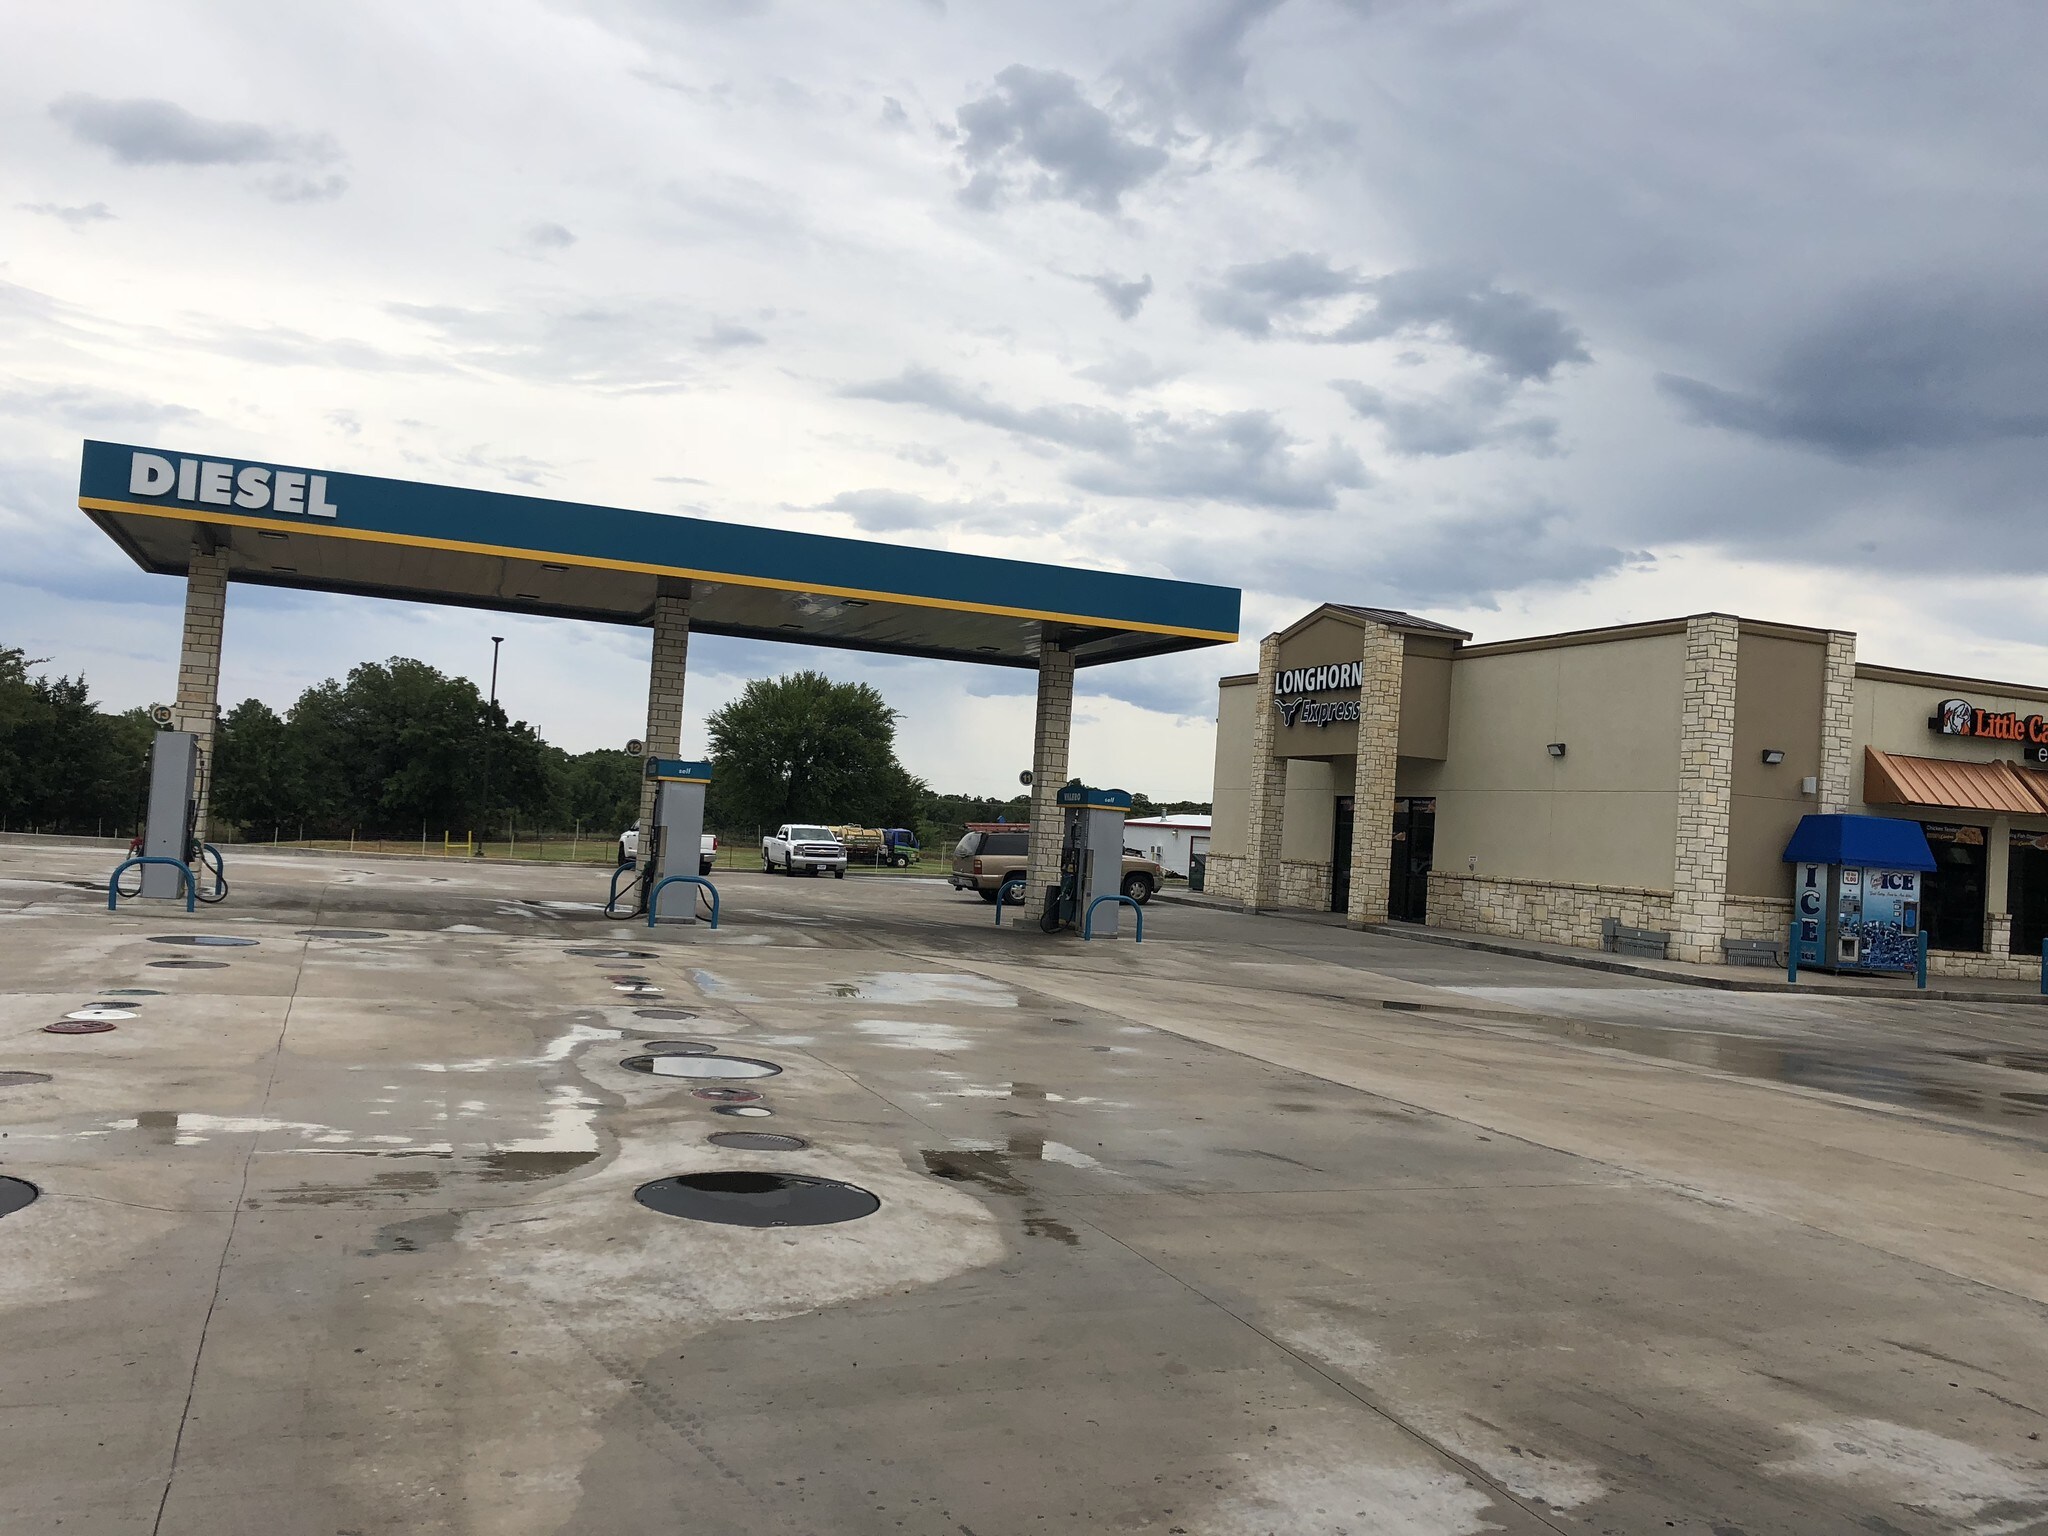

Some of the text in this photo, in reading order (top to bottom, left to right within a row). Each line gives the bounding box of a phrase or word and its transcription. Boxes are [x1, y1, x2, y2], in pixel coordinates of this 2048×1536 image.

[129, 451, 337, 518] DIESEL
[1274, 661, 1363, 695] LONGHORN
[155, 710, 169, 720] 13
[1300, 699, 1361, 727] Express
[1974, 709, 2025, 741] Little
[629, 743, 640, 752] 12
[1881, 871, 1915, 890] ICE
[1800, 864, 1821, 942] ICE
